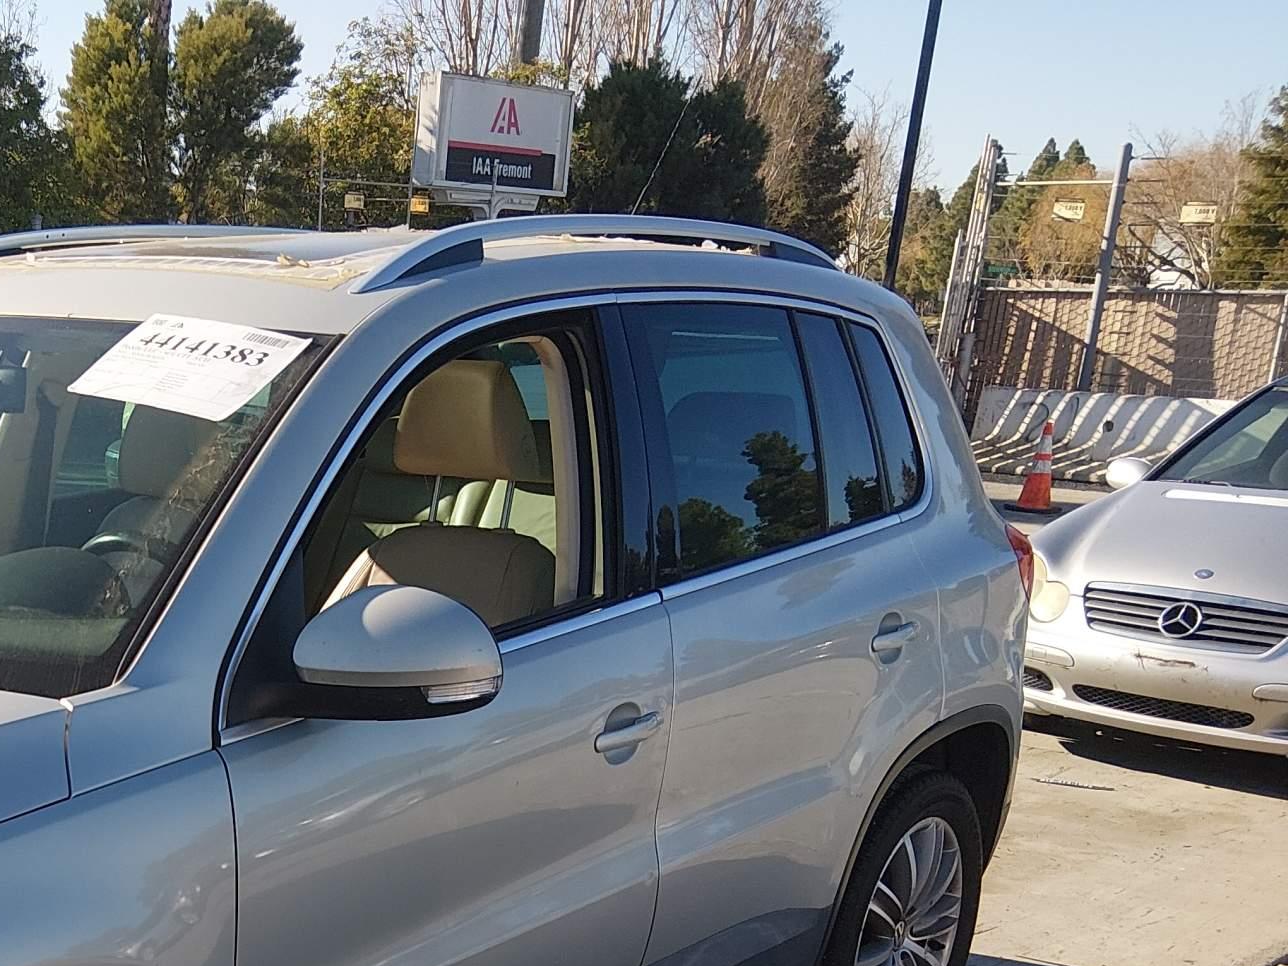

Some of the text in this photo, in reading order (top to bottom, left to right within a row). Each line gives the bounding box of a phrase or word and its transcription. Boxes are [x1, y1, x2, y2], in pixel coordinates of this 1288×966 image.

[472, 156, 533, 180] IAA Fremont
[139, 332, 270, 367] 44141383
